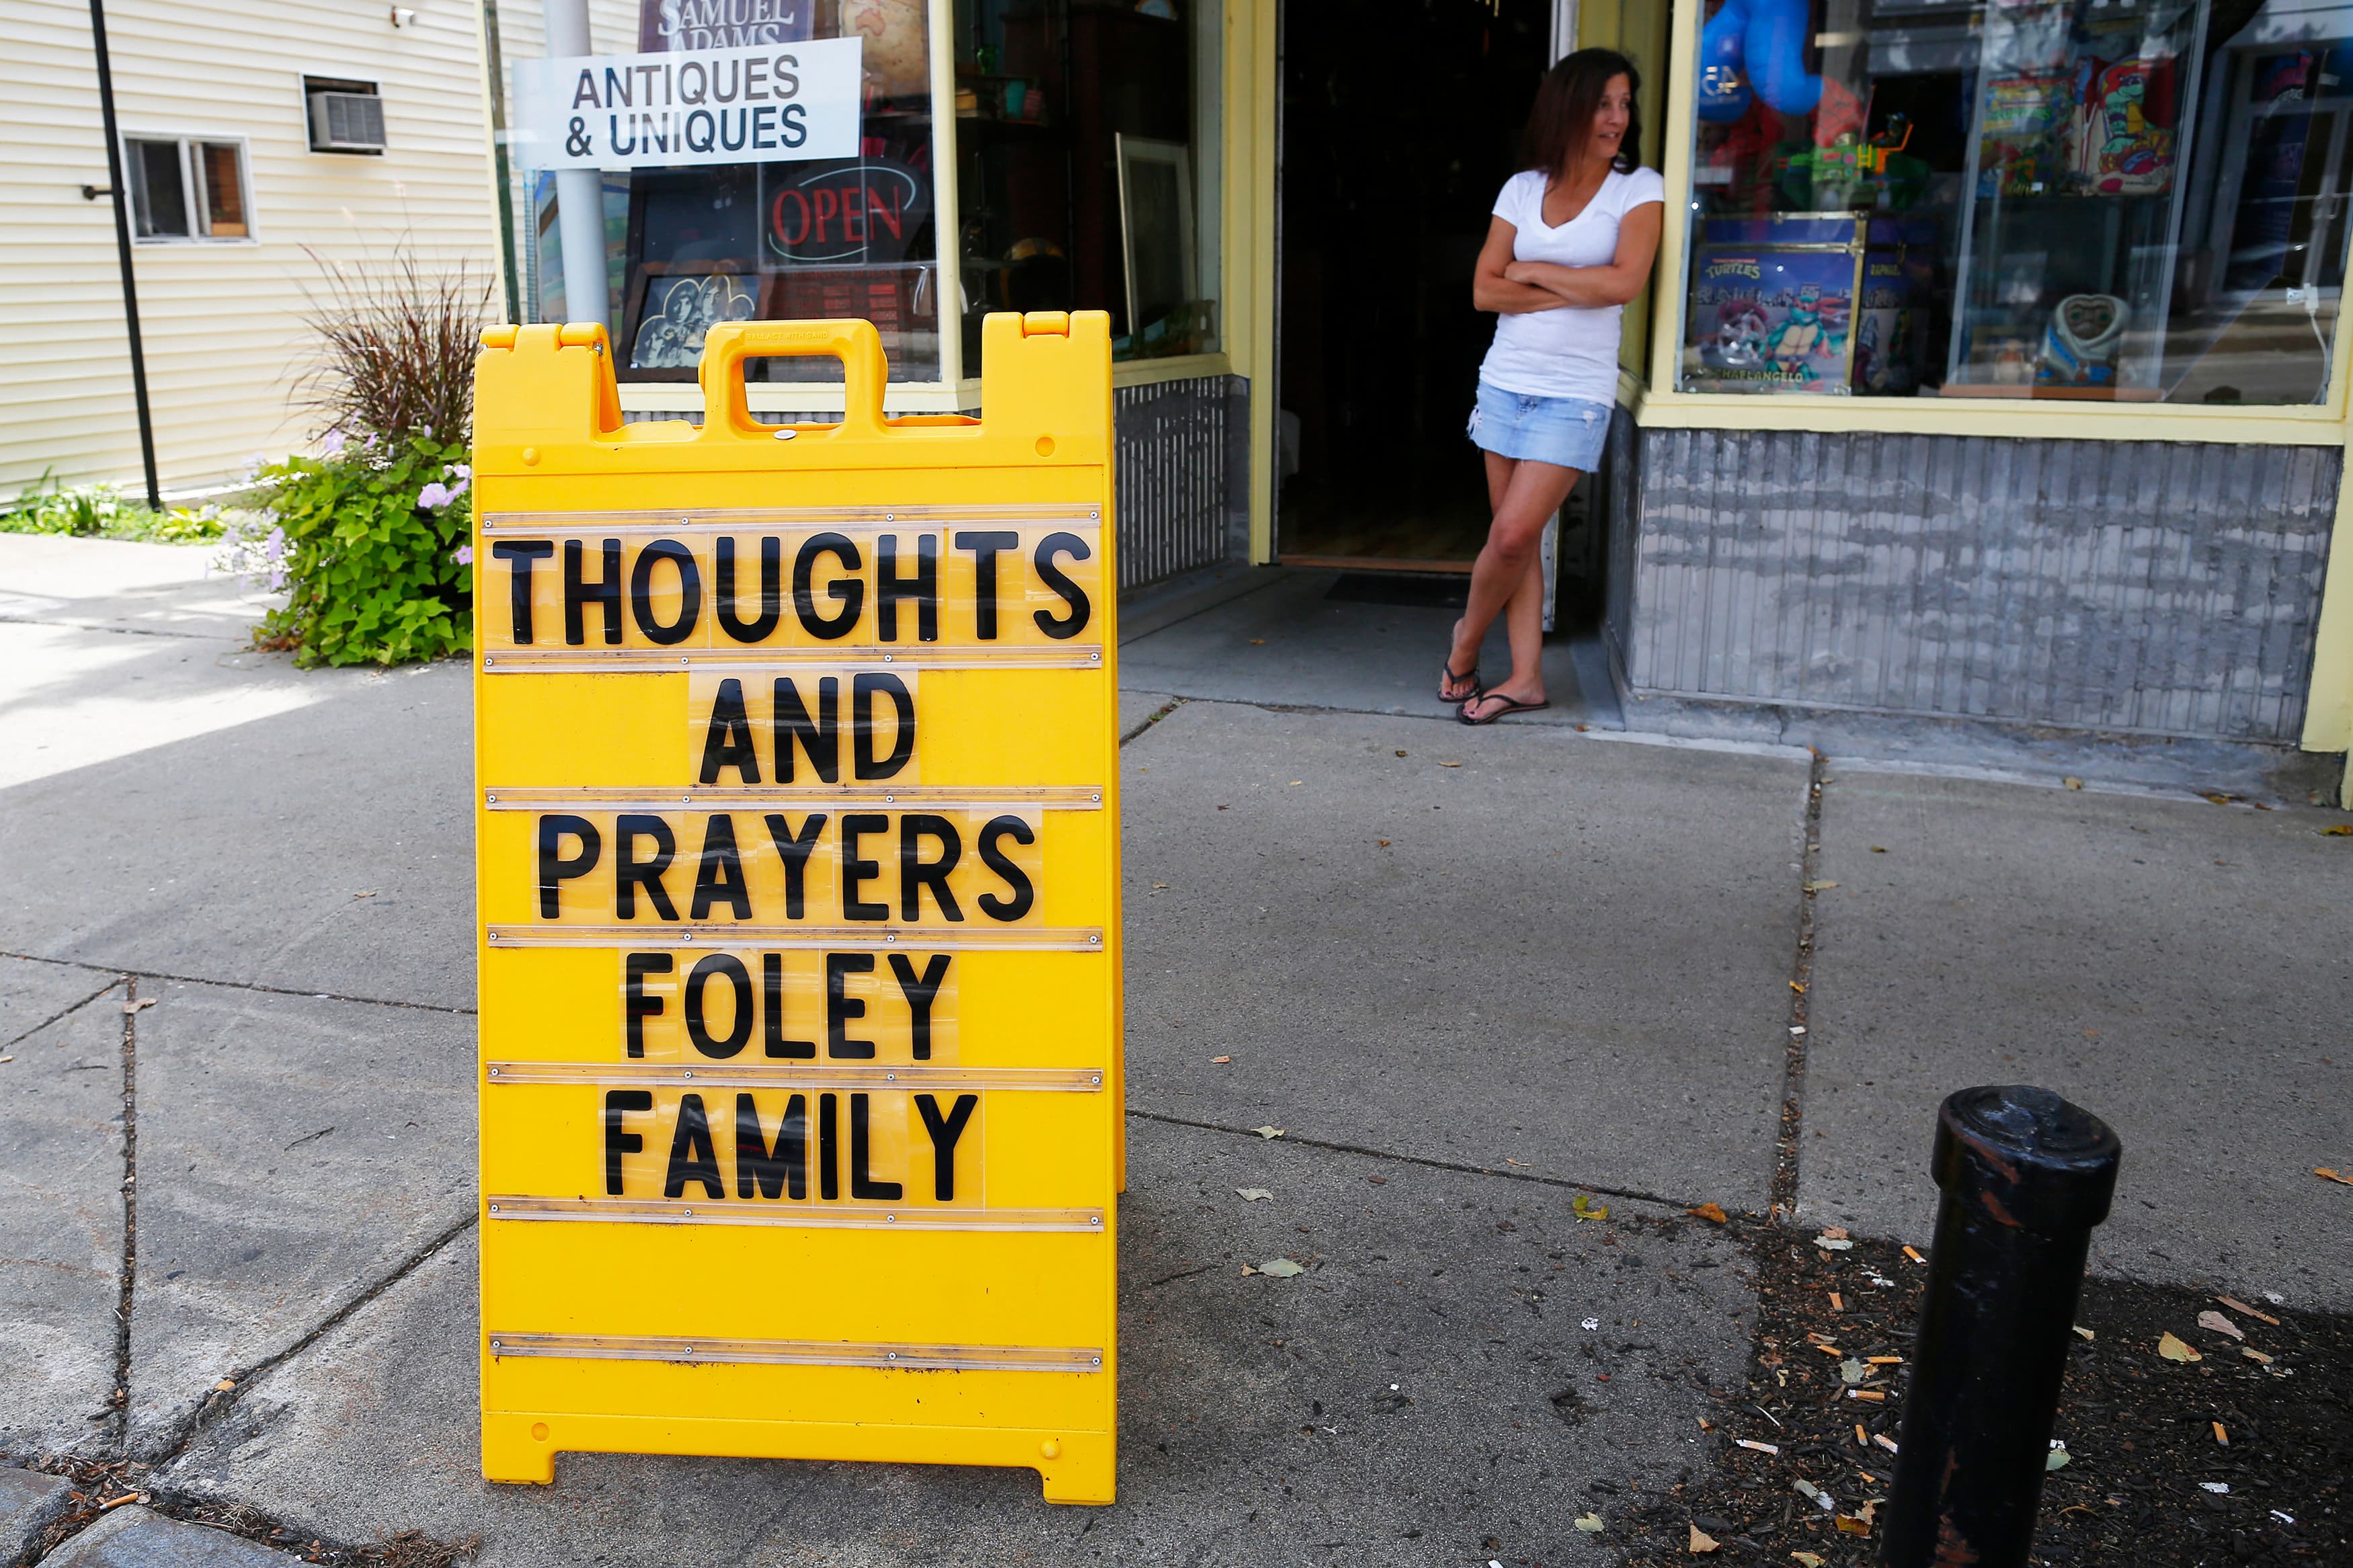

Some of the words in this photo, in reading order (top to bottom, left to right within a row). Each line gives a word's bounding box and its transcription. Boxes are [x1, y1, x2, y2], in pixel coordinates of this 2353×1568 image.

[658, 0, 795, 36] SAMUEL
[668, 24, 781, 52] ADAMS
[571, 54, 800, 110] ANTIQUES
[566, 116, 593, 157] &
[610, 104, 807, 156] UNIQUES
[772, 185, 902, 246] OPEN
[1706, 261, 1761, 280] TURTLES
[785, 332, 805, 340] WITH
[806, 331, 828, 340] SAND
[493, 532, 1090, 645] THOUGHTS
[699, 673, 914, 784] AND
[539, 814, 1035, 921] PRAYERS
[627, 953, 951, 1060] FOLEY
[606, 1090, 978, 1201] FAMILY
